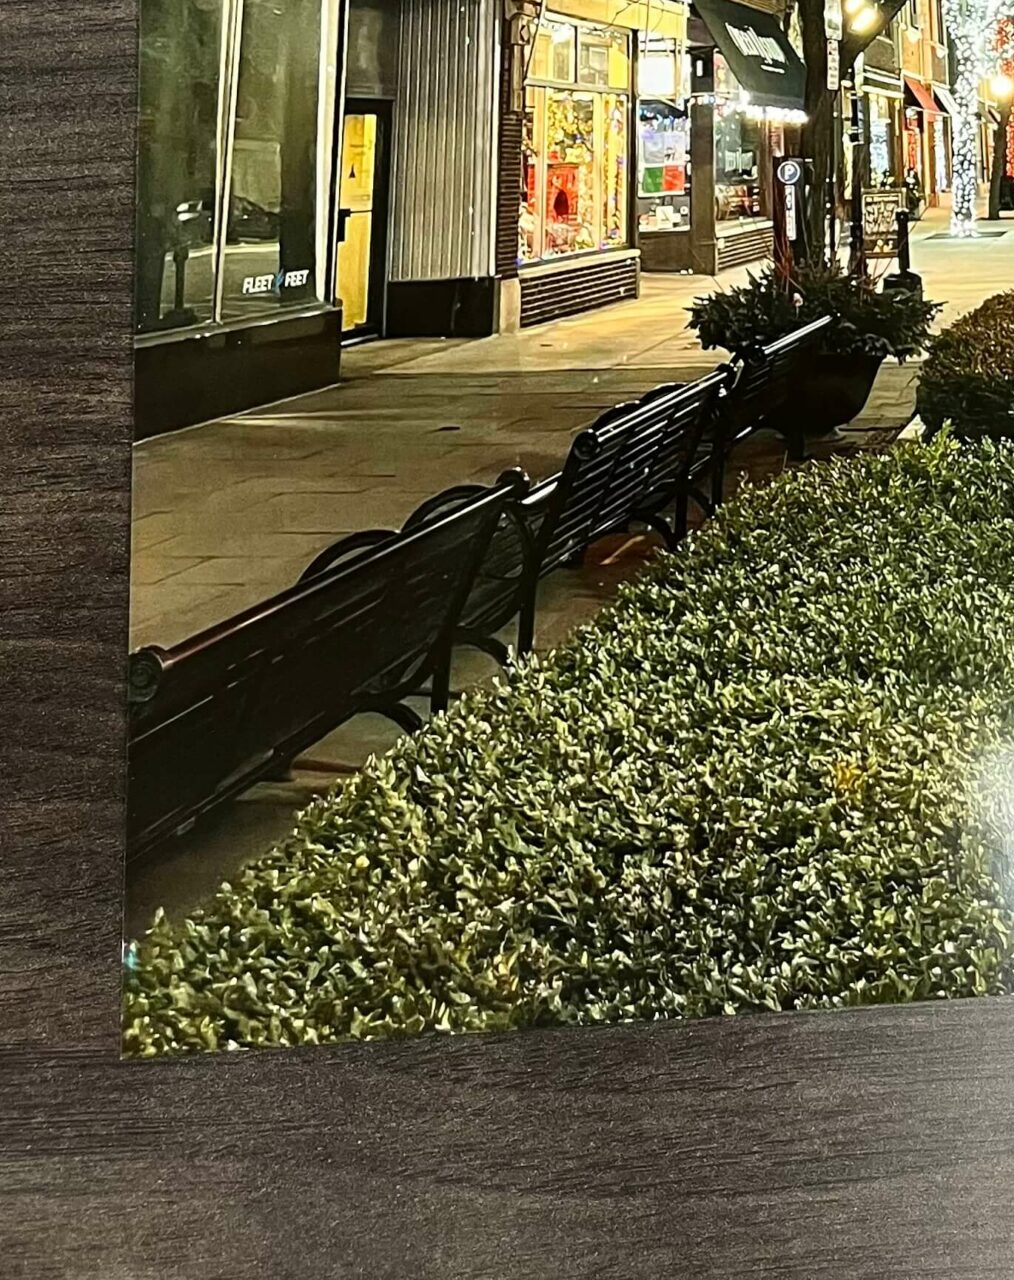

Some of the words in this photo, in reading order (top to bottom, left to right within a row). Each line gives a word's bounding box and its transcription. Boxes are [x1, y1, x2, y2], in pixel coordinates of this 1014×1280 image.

[783, 163, 793, 181] P
[242, 274, 275, 294] FLEET
[284, 269, 310, 288] FEET
